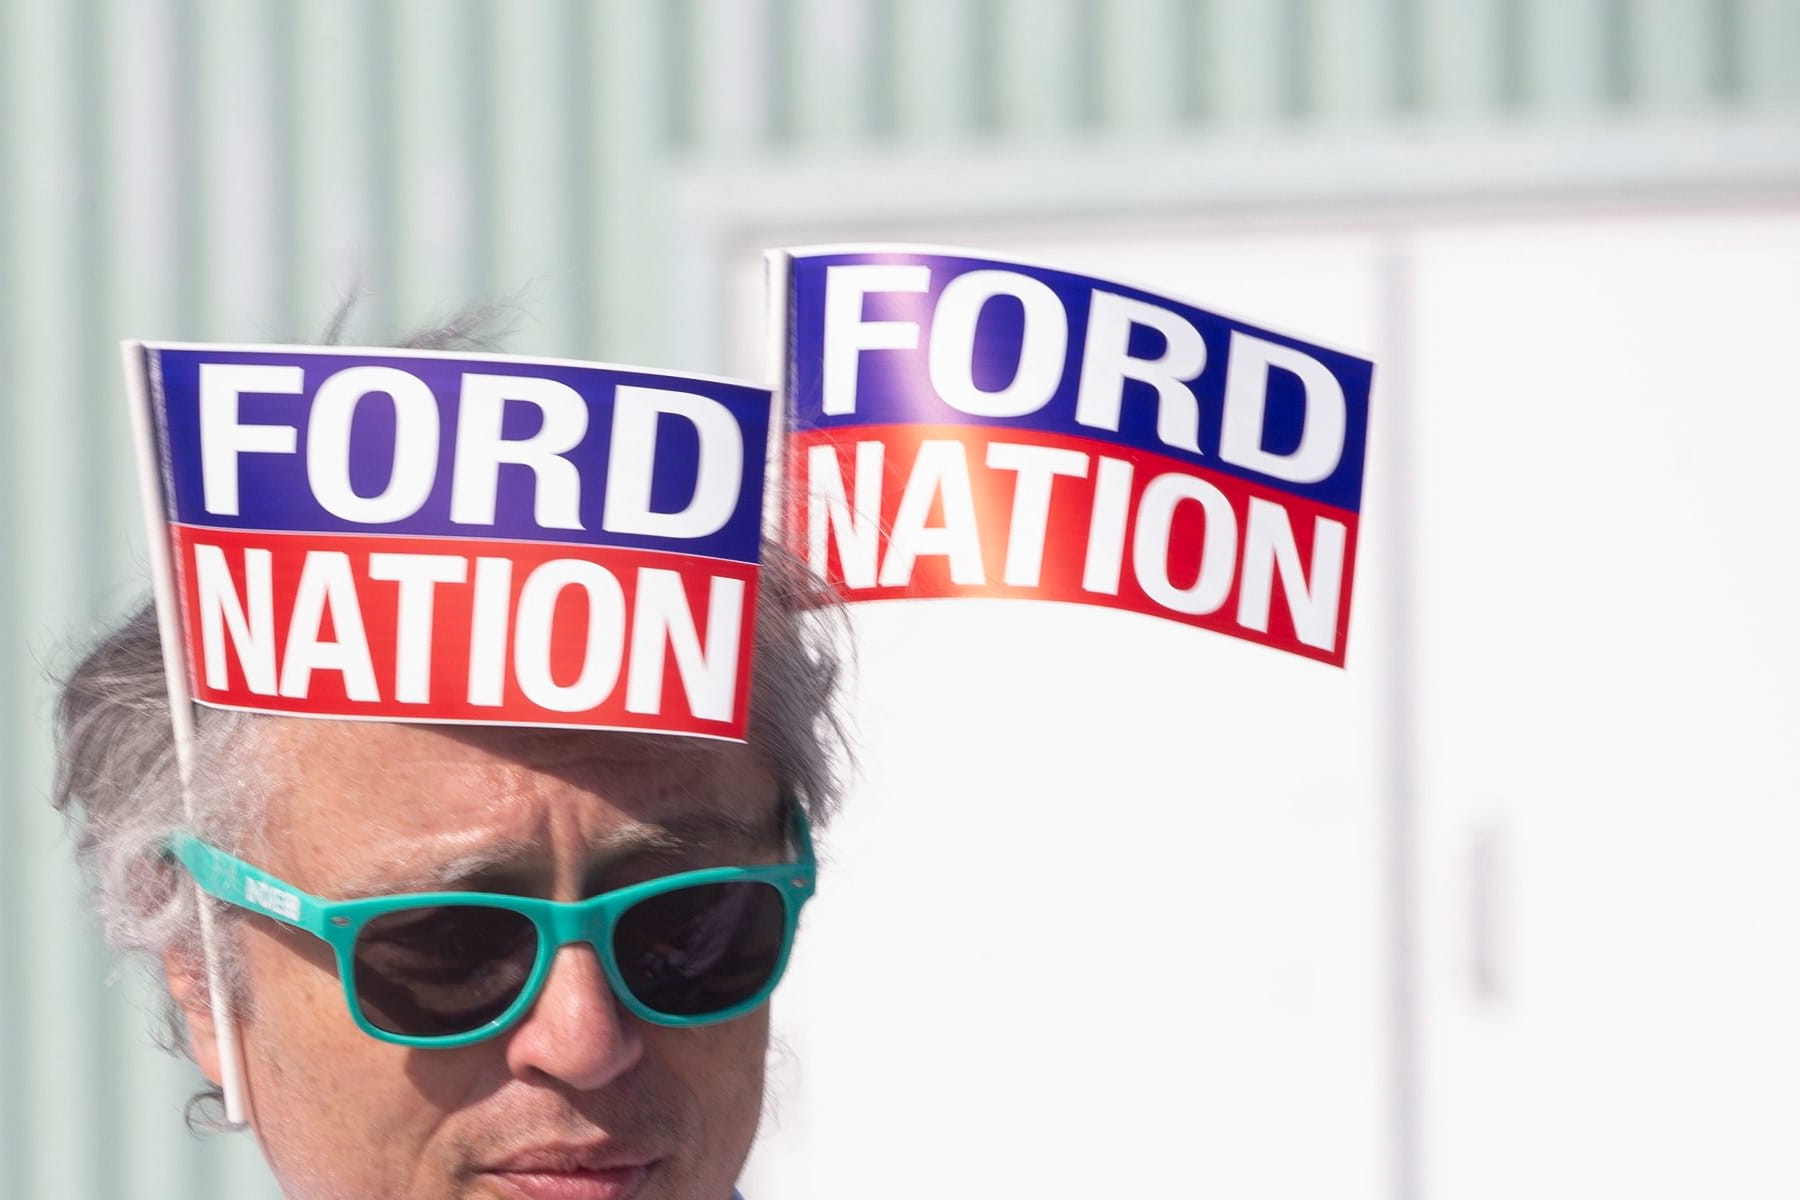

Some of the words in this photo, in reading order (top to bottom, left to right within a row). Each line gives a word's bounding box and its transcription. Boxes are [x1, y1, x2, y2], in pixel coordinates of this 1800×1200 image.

[198, 363, 745, 540] FORD
[822, 265, 1347, 484] FORD
[193, 543, 745, 723] NATION
[806, 439, 1347, 654] NATION
